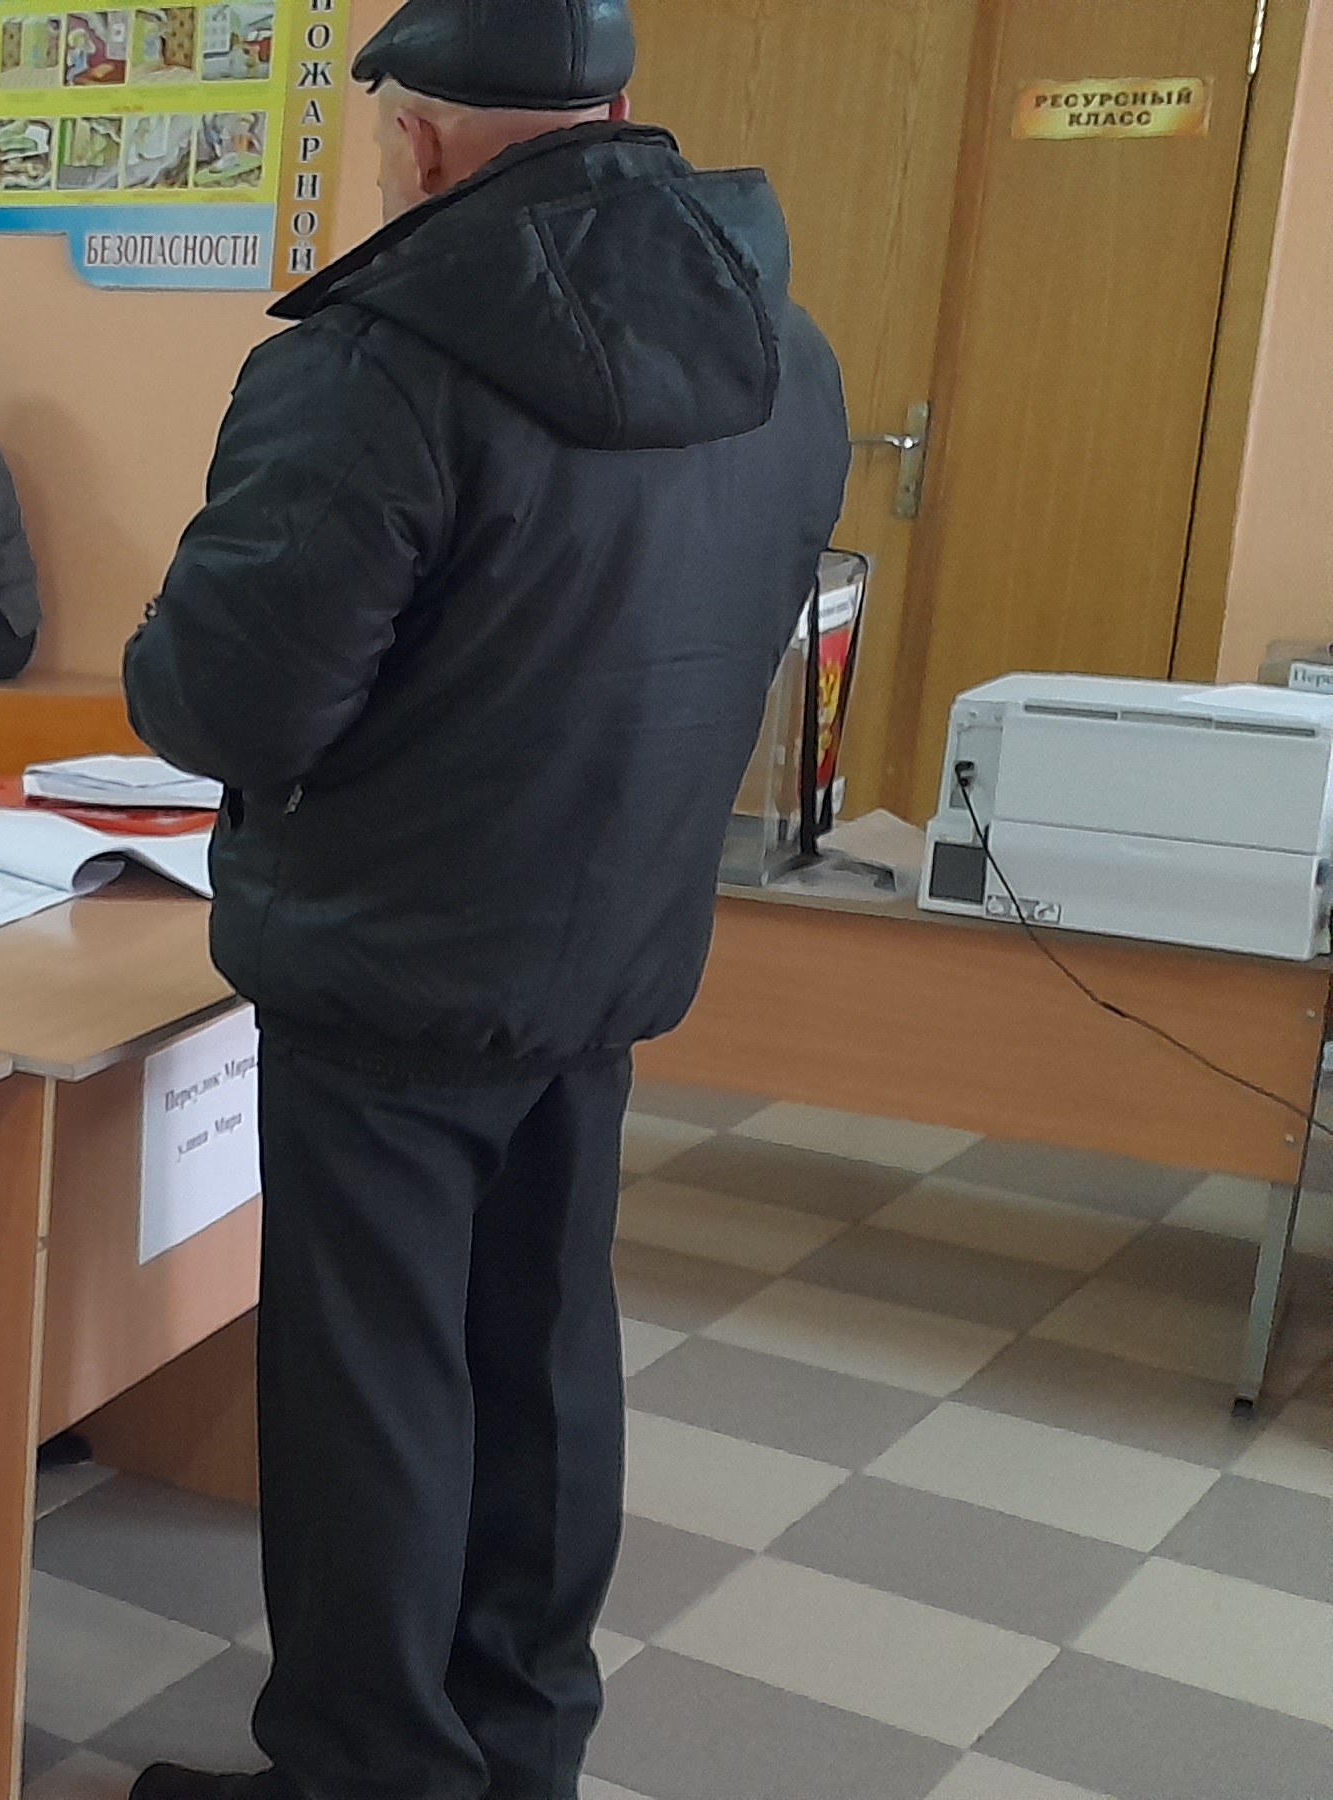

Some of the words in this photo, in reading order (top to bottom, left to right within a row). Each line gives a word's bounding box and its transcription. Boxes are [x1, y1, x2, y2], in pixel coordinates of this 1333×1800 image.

[1034, 86, 1193, 108] РЕСУРСНЫЙ
[1068, 110, 1152, 126] КЛАСС
[85, 234, 260, 267] БЕЗОПАСНОСТИ
